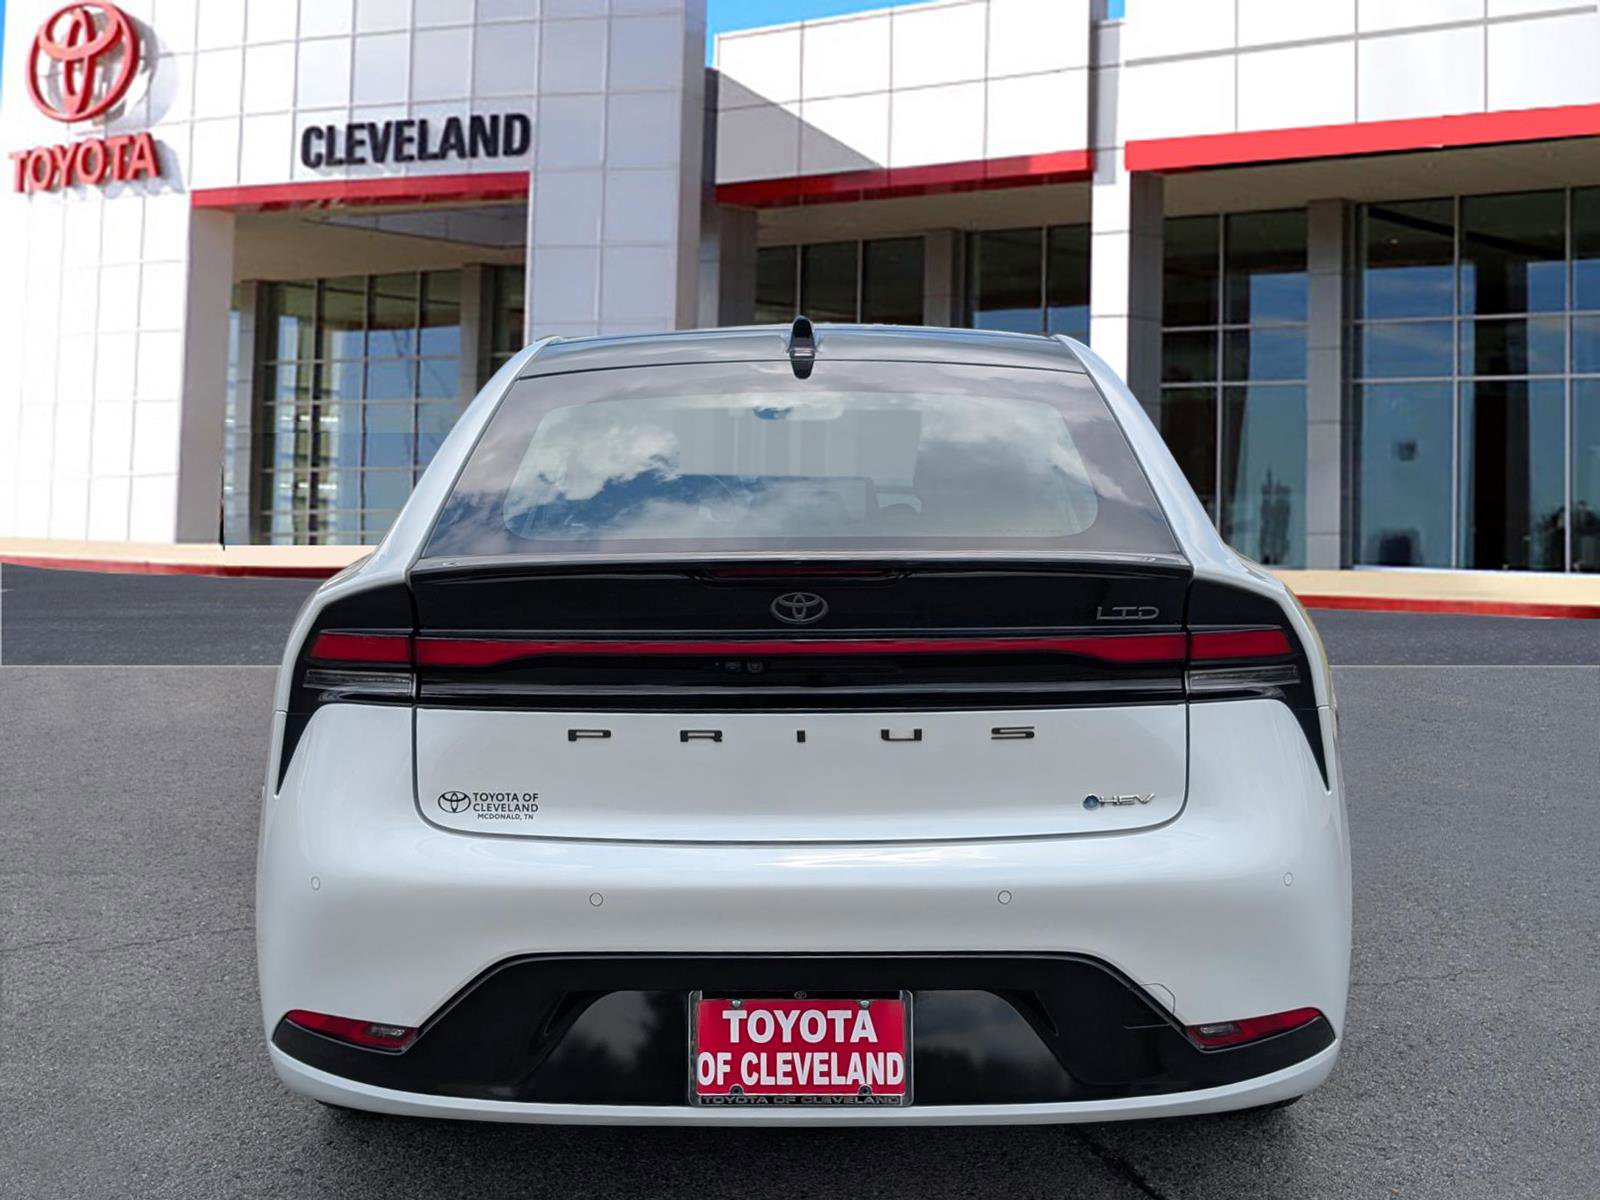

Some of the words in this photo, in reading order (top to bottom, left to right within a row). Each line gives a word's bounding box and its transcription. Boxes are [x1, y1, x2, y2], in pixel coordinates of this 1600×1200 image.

[301, 113, 531, 169] CLEVELAND
[9, 131, 162, 193] TOYOTA
[1096, 606, 1160, 620] LTD
[568, 726, 1035, 743] PRIUS
[472, 792, 519, 802] TOYOTA
[522, 792, 539, 802] OF
[1100, 793, 1155, 807] HEV
[473, 803, 539, 813] CLEVELAND
[477, 813, 522, 821] MCDONALD,
[722, 1009, 878, 1043] TOYOTA
[697, 1052, 731, 1086] OF
[740, 1052, 904, 1086] CLEVELAND
[704, 1096, 769, 1104] TOYOTA
